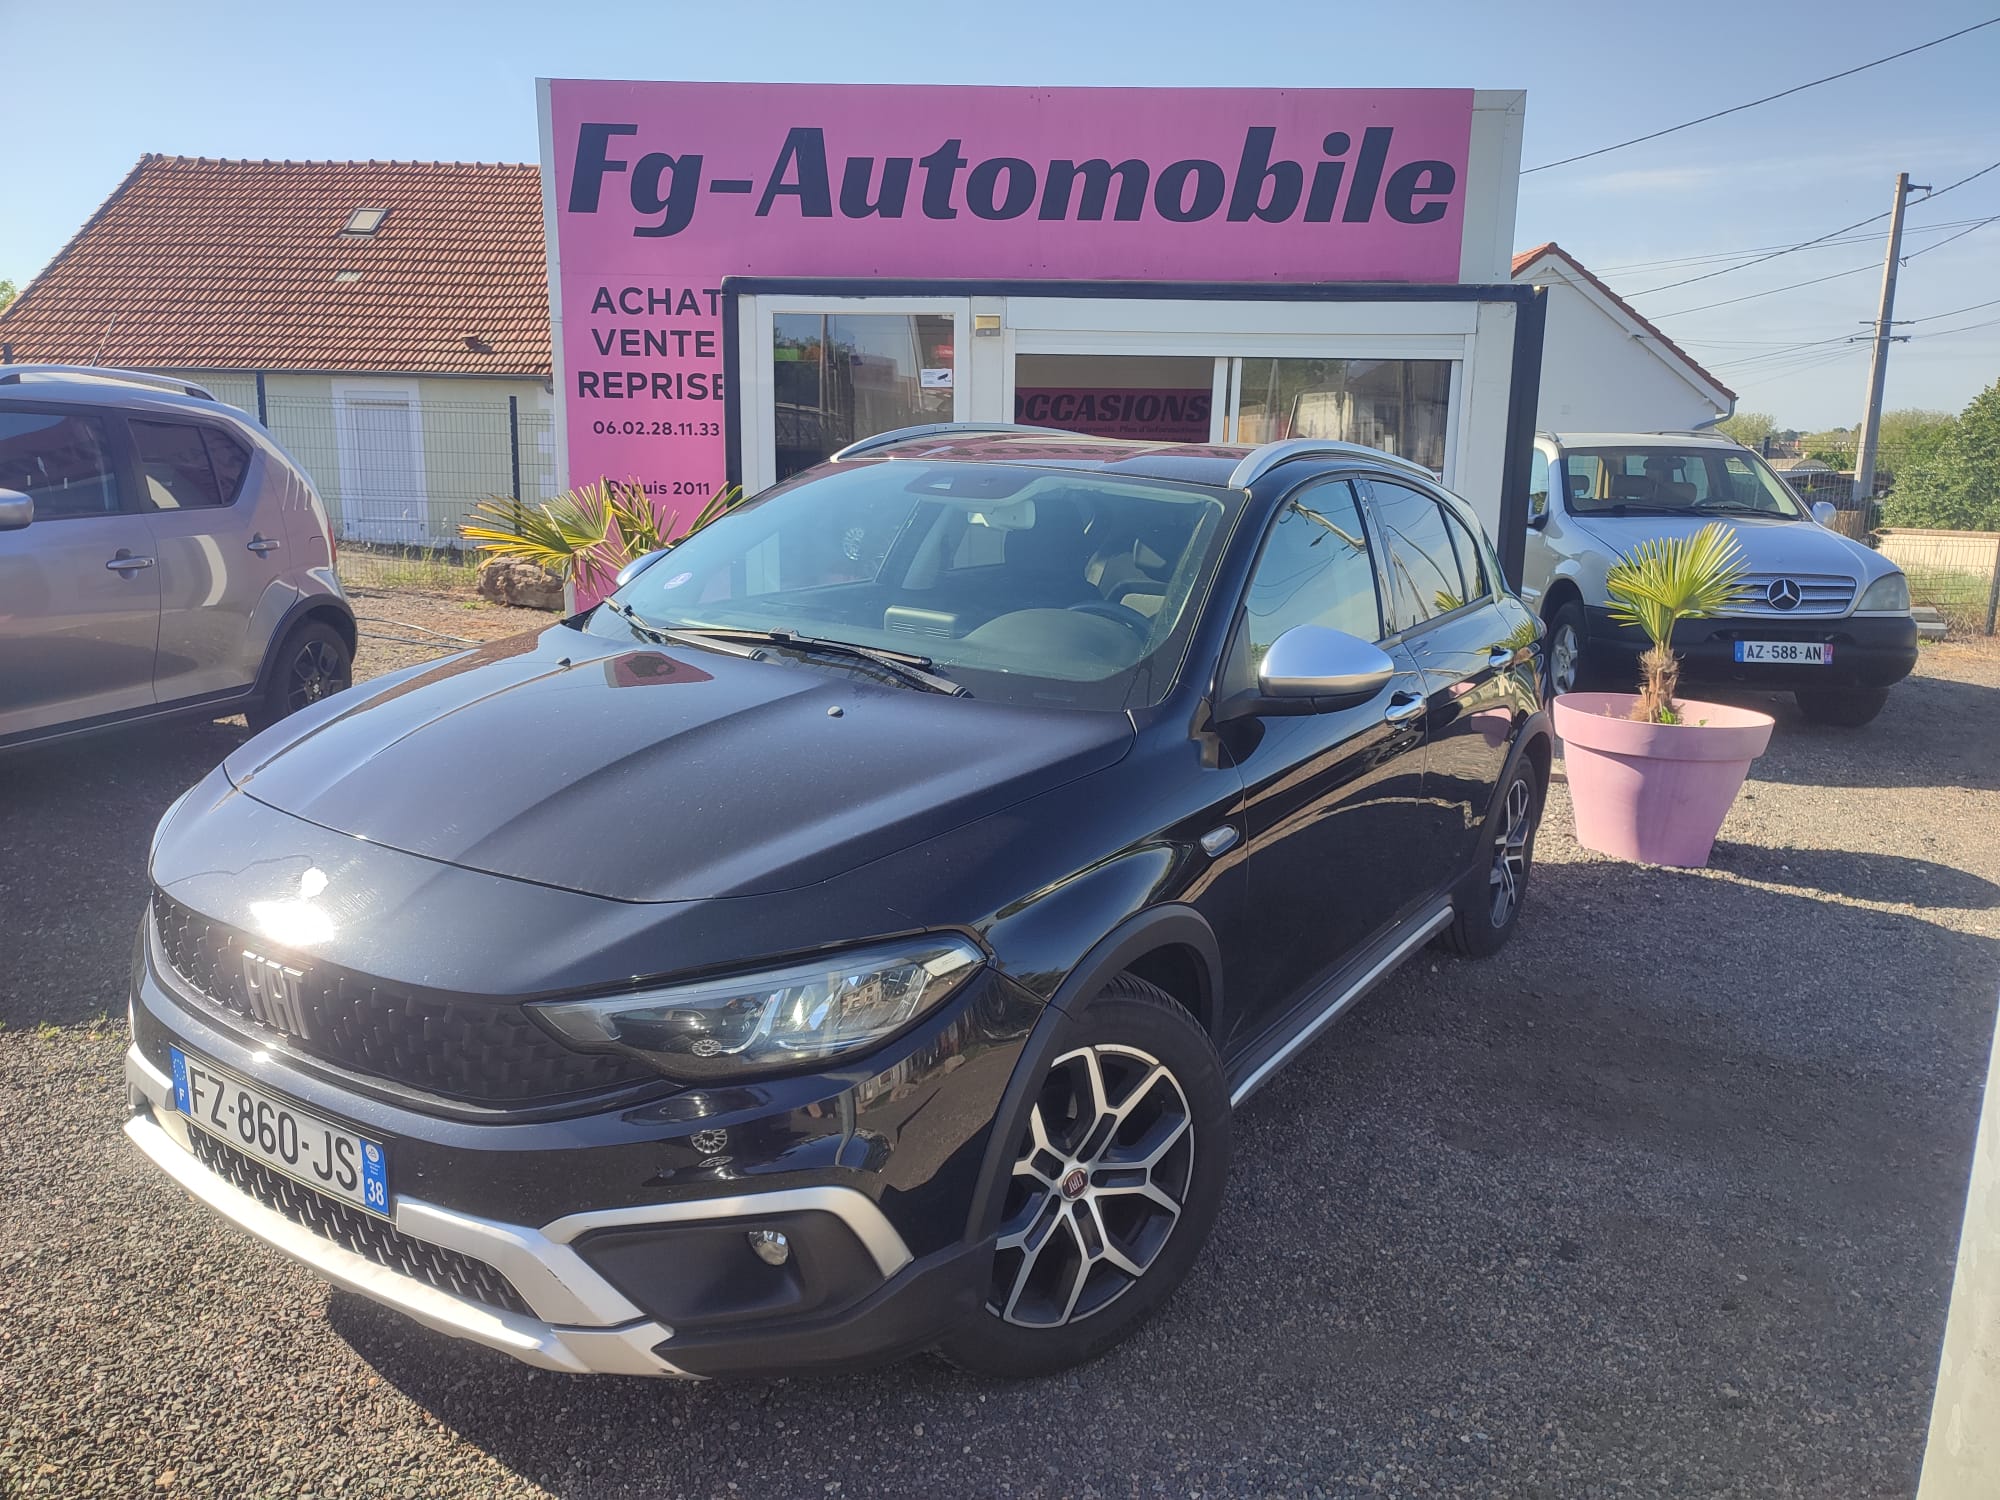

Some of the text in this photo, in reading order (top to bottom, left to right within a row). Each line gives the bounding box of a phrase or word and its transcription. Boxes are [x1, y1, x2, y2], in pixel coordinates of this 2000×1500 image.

[567, 122, 1456, 238] Fg-Automobile
[590, 286, 721, 316] ACHAT
[591, 328, 716, 358] VENTE
[577, 370, 724, 401] REPRISE
[592, 420, 720, 436] 06.02.28.11.33
[673, 481, 710, 495] 2011
[1746, 645, 1822, 660] AZ-588-AN
[242, 950, 311, 1040] FIAT
[178, 1087, 185, 1101] F
[189, 1065, 358, 1192] FZ-860-JS
[367, 1177, 385, 1206] 38
